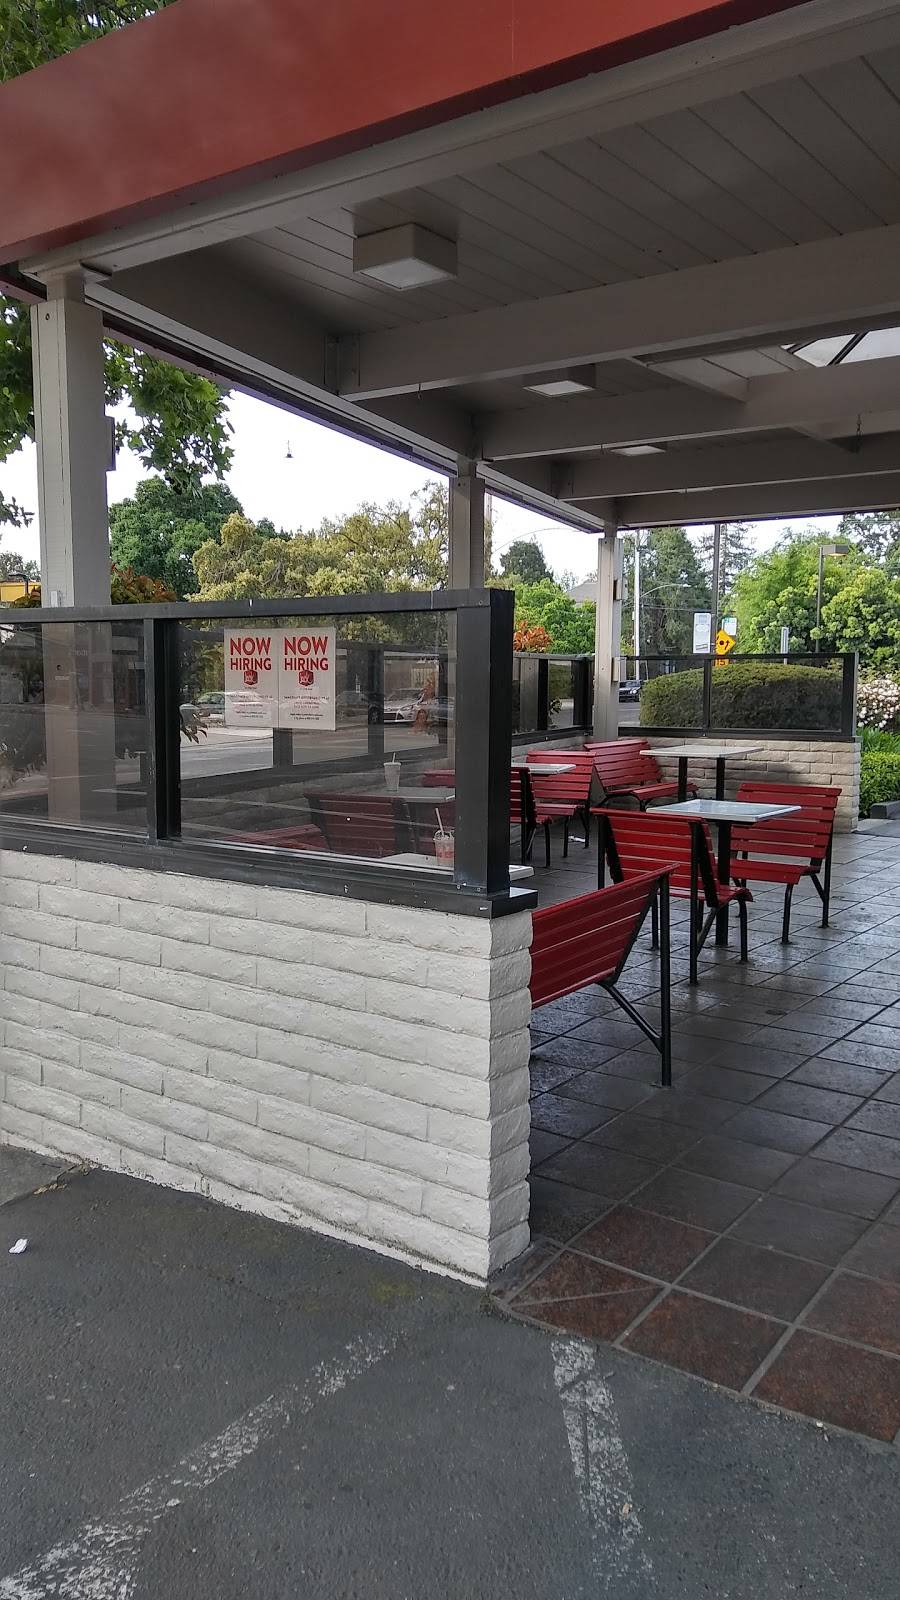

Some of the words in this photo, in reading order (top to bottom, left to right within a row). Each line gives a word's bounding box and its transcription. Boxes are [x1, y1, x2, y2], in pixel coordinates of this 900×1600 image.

[230, 637, 271, 656] NOW
[284, 636, 328, 656] NOW
[230, 658, 272, 671] HIRING
[284, 658, 329, 671] HIRING
